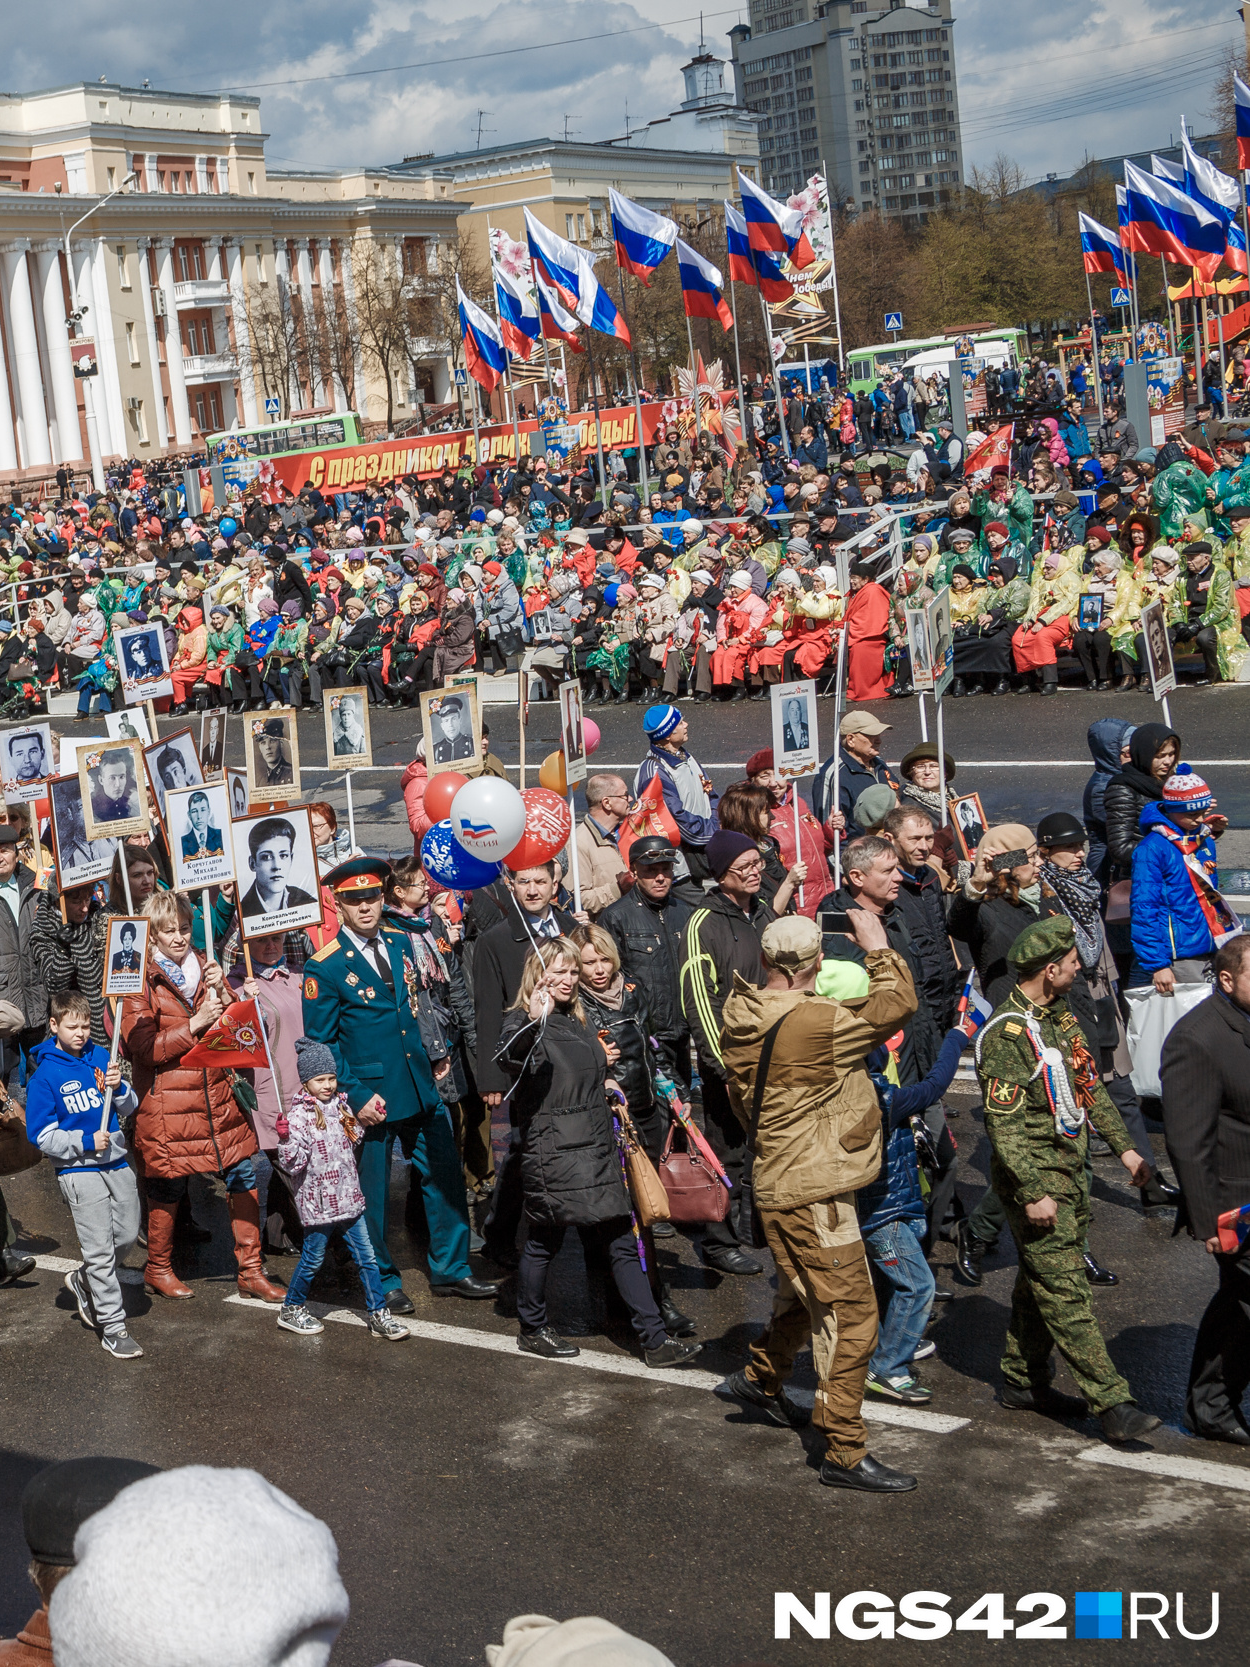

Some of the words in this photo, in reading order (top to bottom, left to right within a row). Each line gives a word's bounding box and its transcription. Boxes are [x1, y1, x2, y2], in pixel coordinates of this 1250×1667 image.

[309, 455, 324, 489] С
[327, 441, 460, 487] праздником
[578, 413, 636, 448] беды!
[250, 922, 275, 932] Василий
[276, 914, 312, 927] Григорьевич
[261, 910, 298, 922] Коновальчик
